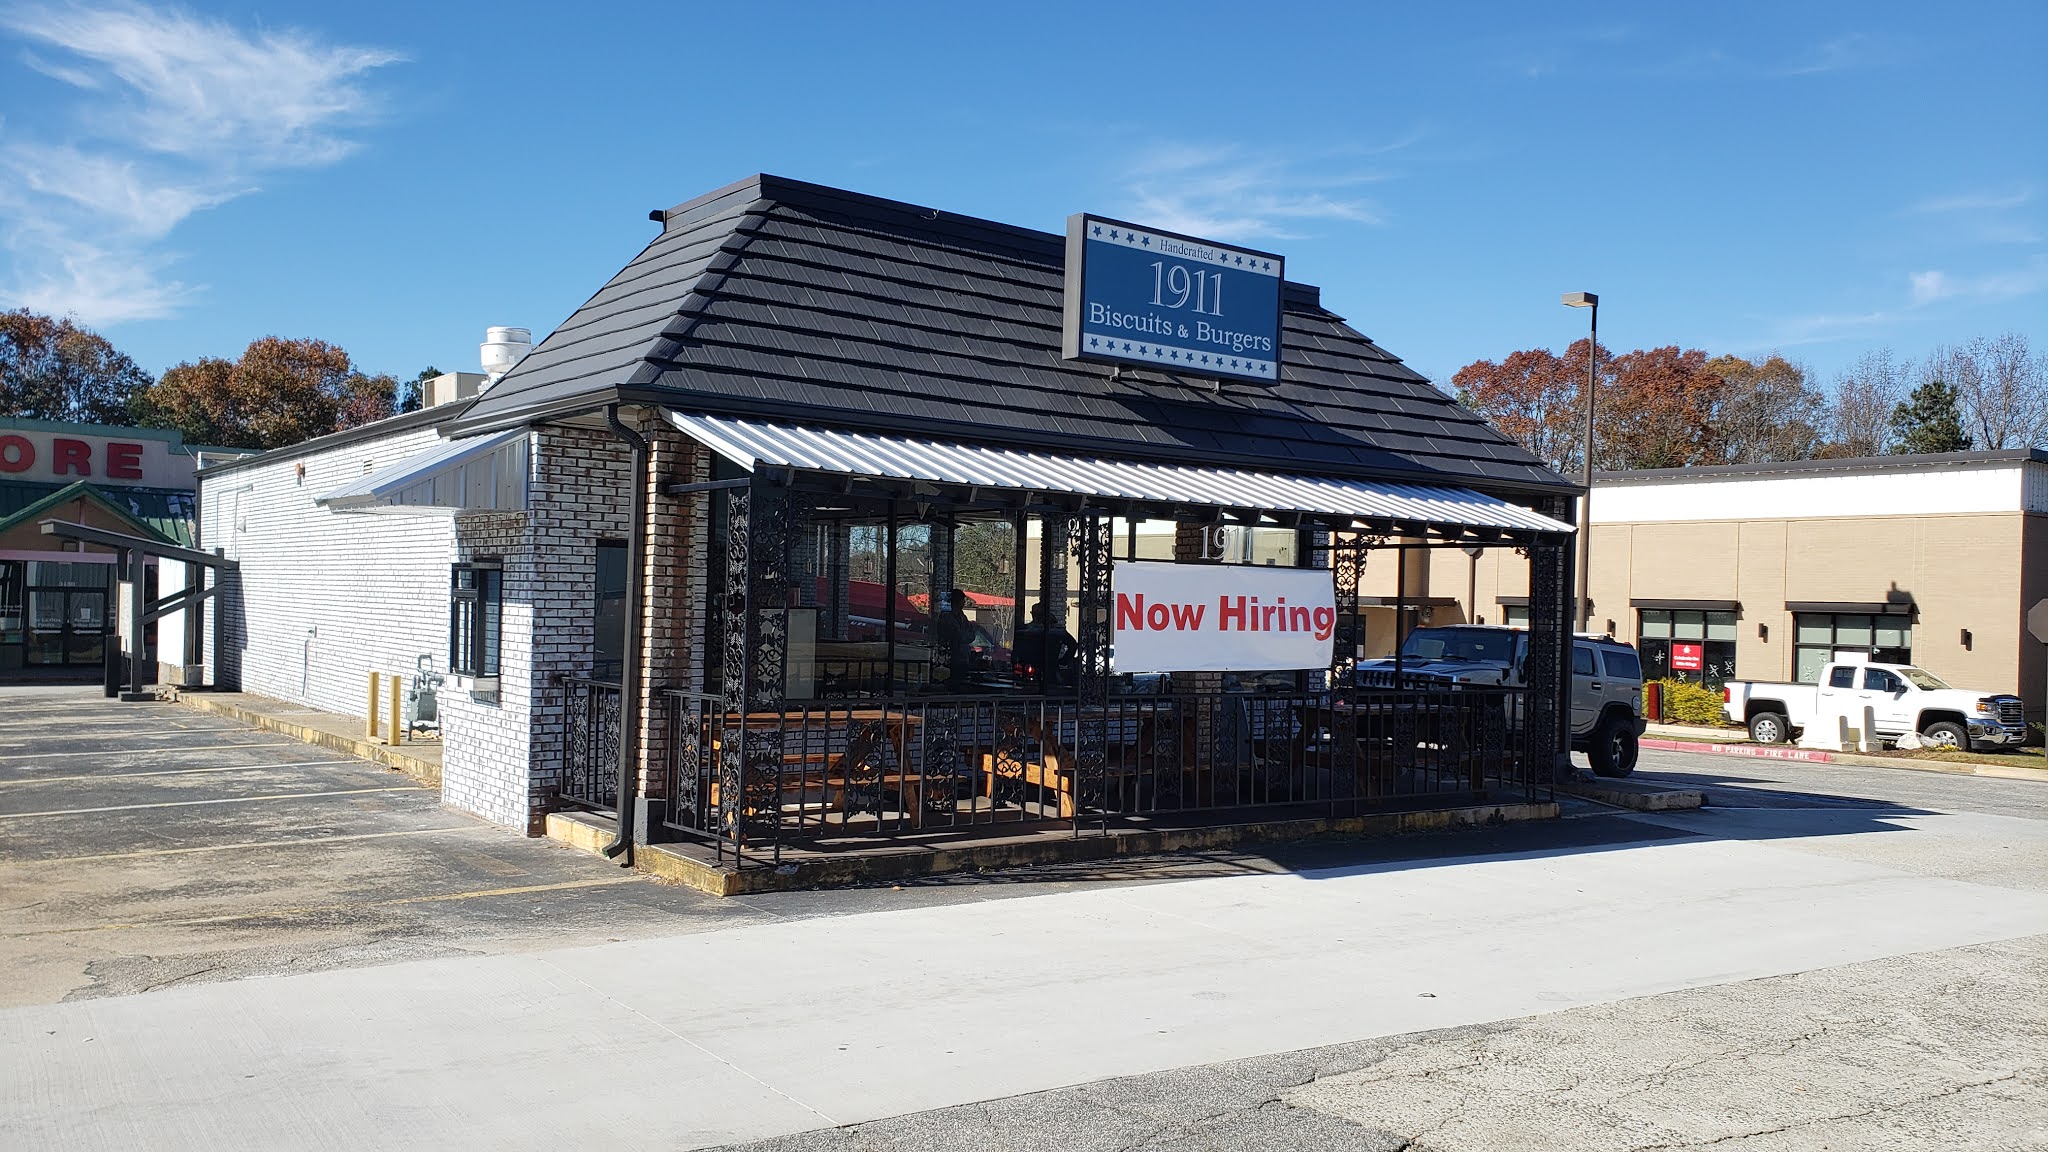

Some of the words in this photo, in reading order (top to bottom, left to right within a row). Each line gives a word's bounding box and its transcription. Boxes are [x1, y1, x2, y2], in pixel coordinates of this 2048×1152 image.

[1160, 239, 1213, 261] Handcrafted
[1148, 261, 1224, 317] 1911
[1088, 302, 1173, 336] Biscuits
[1177, 324, 1189, 339] &
[1196, 321, 1272, 353] Burgers
[0, 434, 144, 480] ORE
[1116, 592, 1206, 631] Now
[1219, 595, 1335, 641] Hiring
[1711, 744, 1722, 752] NO
[1725, 746, 1756, 756] PARKING
[1764, 749, 1784, 759] FIRE
[1787, 751, 1810, 760] LANE
